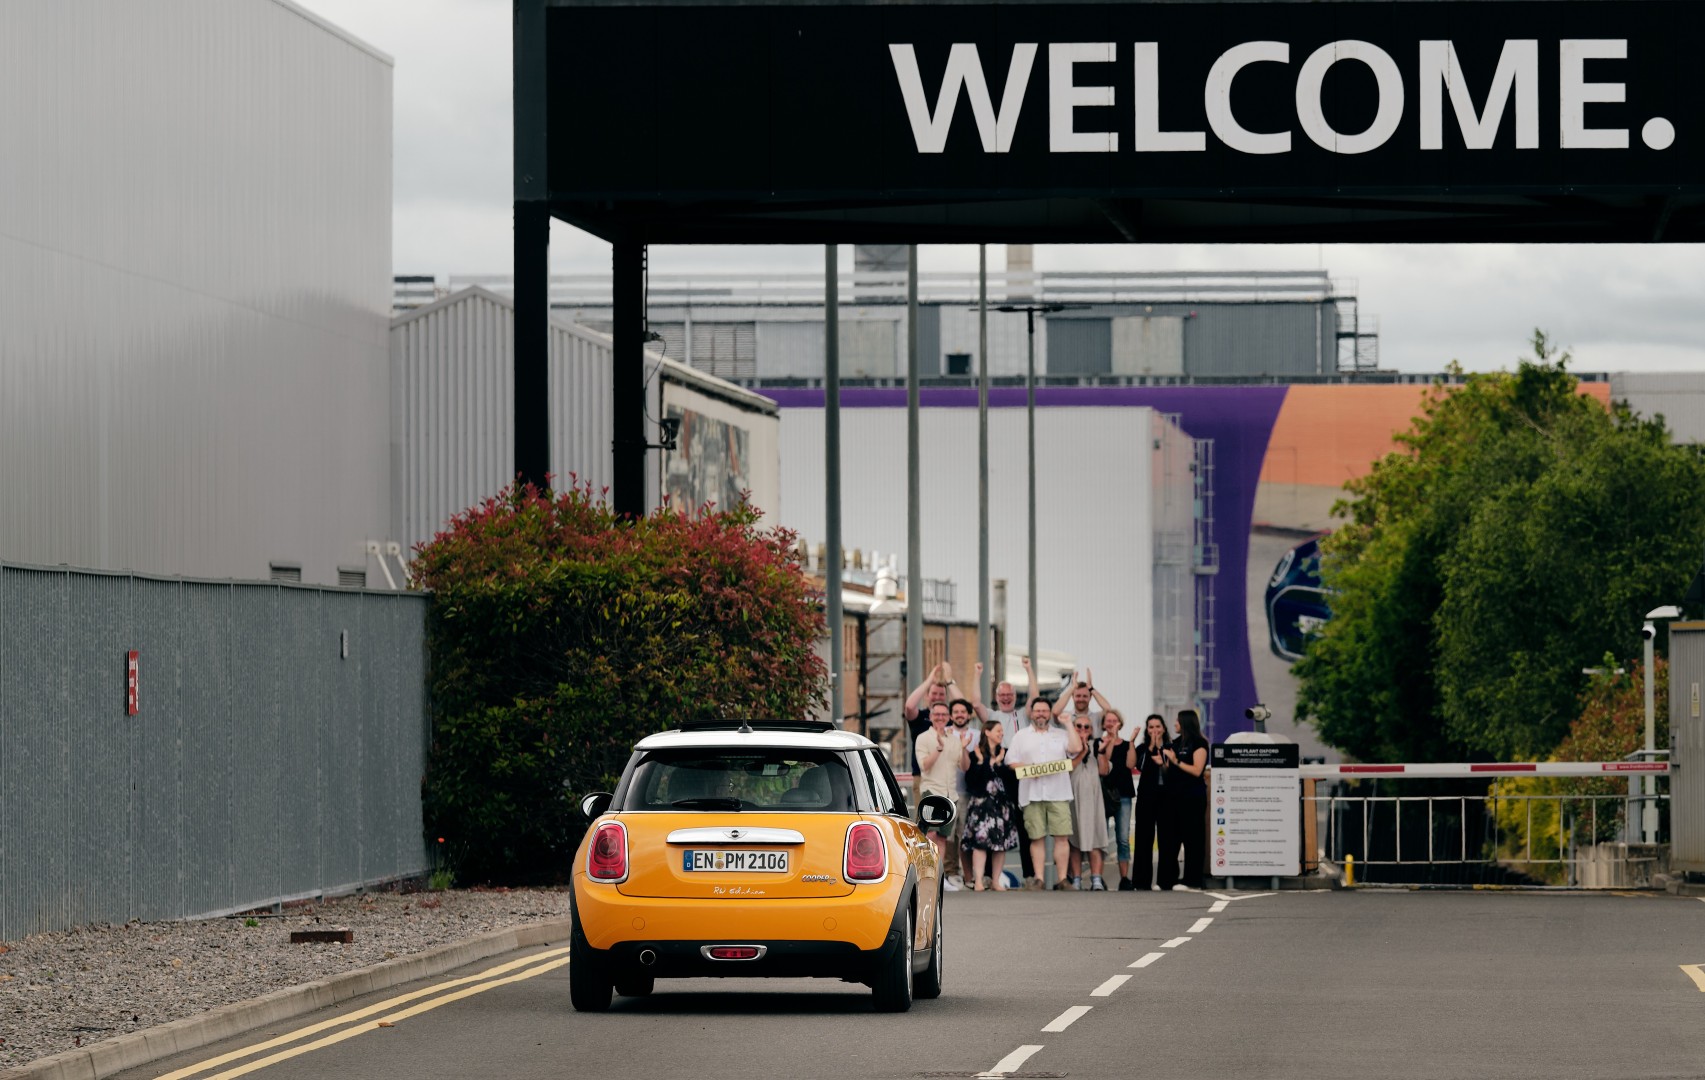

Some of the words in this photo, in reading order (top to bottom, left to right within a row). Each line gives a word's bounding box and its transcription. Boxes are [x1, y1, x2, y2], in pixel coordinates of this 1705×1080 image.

[888, 38, 1675, 155] WELCOME.
[1022, 768, 1028, 776] 1
[694, 852, 714, 869] EN
[725, 853, 745, 869] PM
[748, 853, 786, 870] 2106
[802, 874, 830, 882] COOPER
